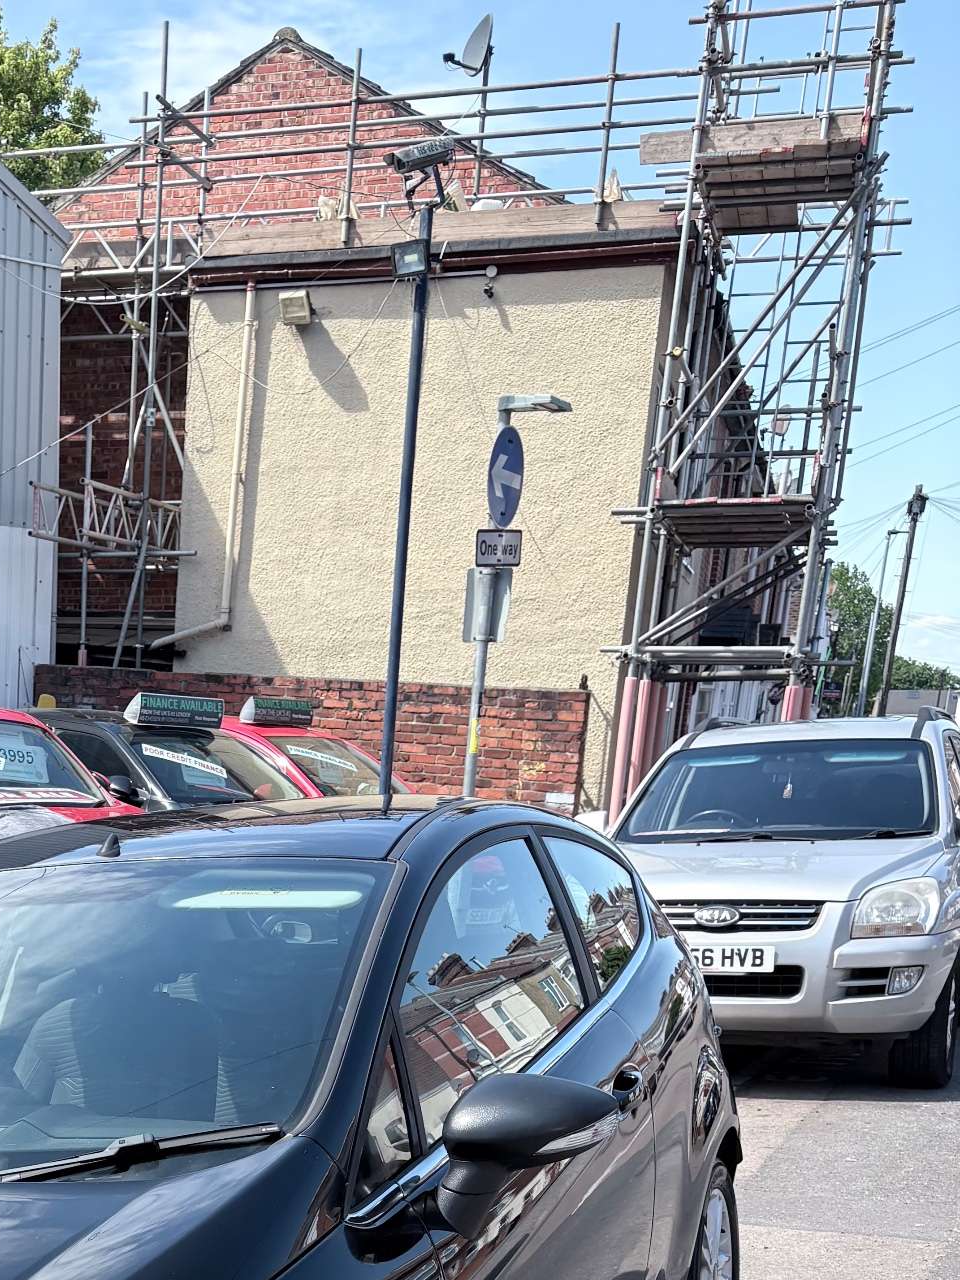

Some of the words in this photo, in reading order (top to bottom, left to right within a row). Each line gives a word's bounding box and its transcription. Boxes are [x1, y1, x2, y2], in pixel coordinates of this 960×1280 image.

[479, 540, 498, 556] One
[501, 544, 519, 559] way
[141, 696, 180, 710] FINANCE
[180, 699, 223, 713] AVAILABLE
[702, 909, 732, 922] KIA
[721, 948, 765, 967] HVB
